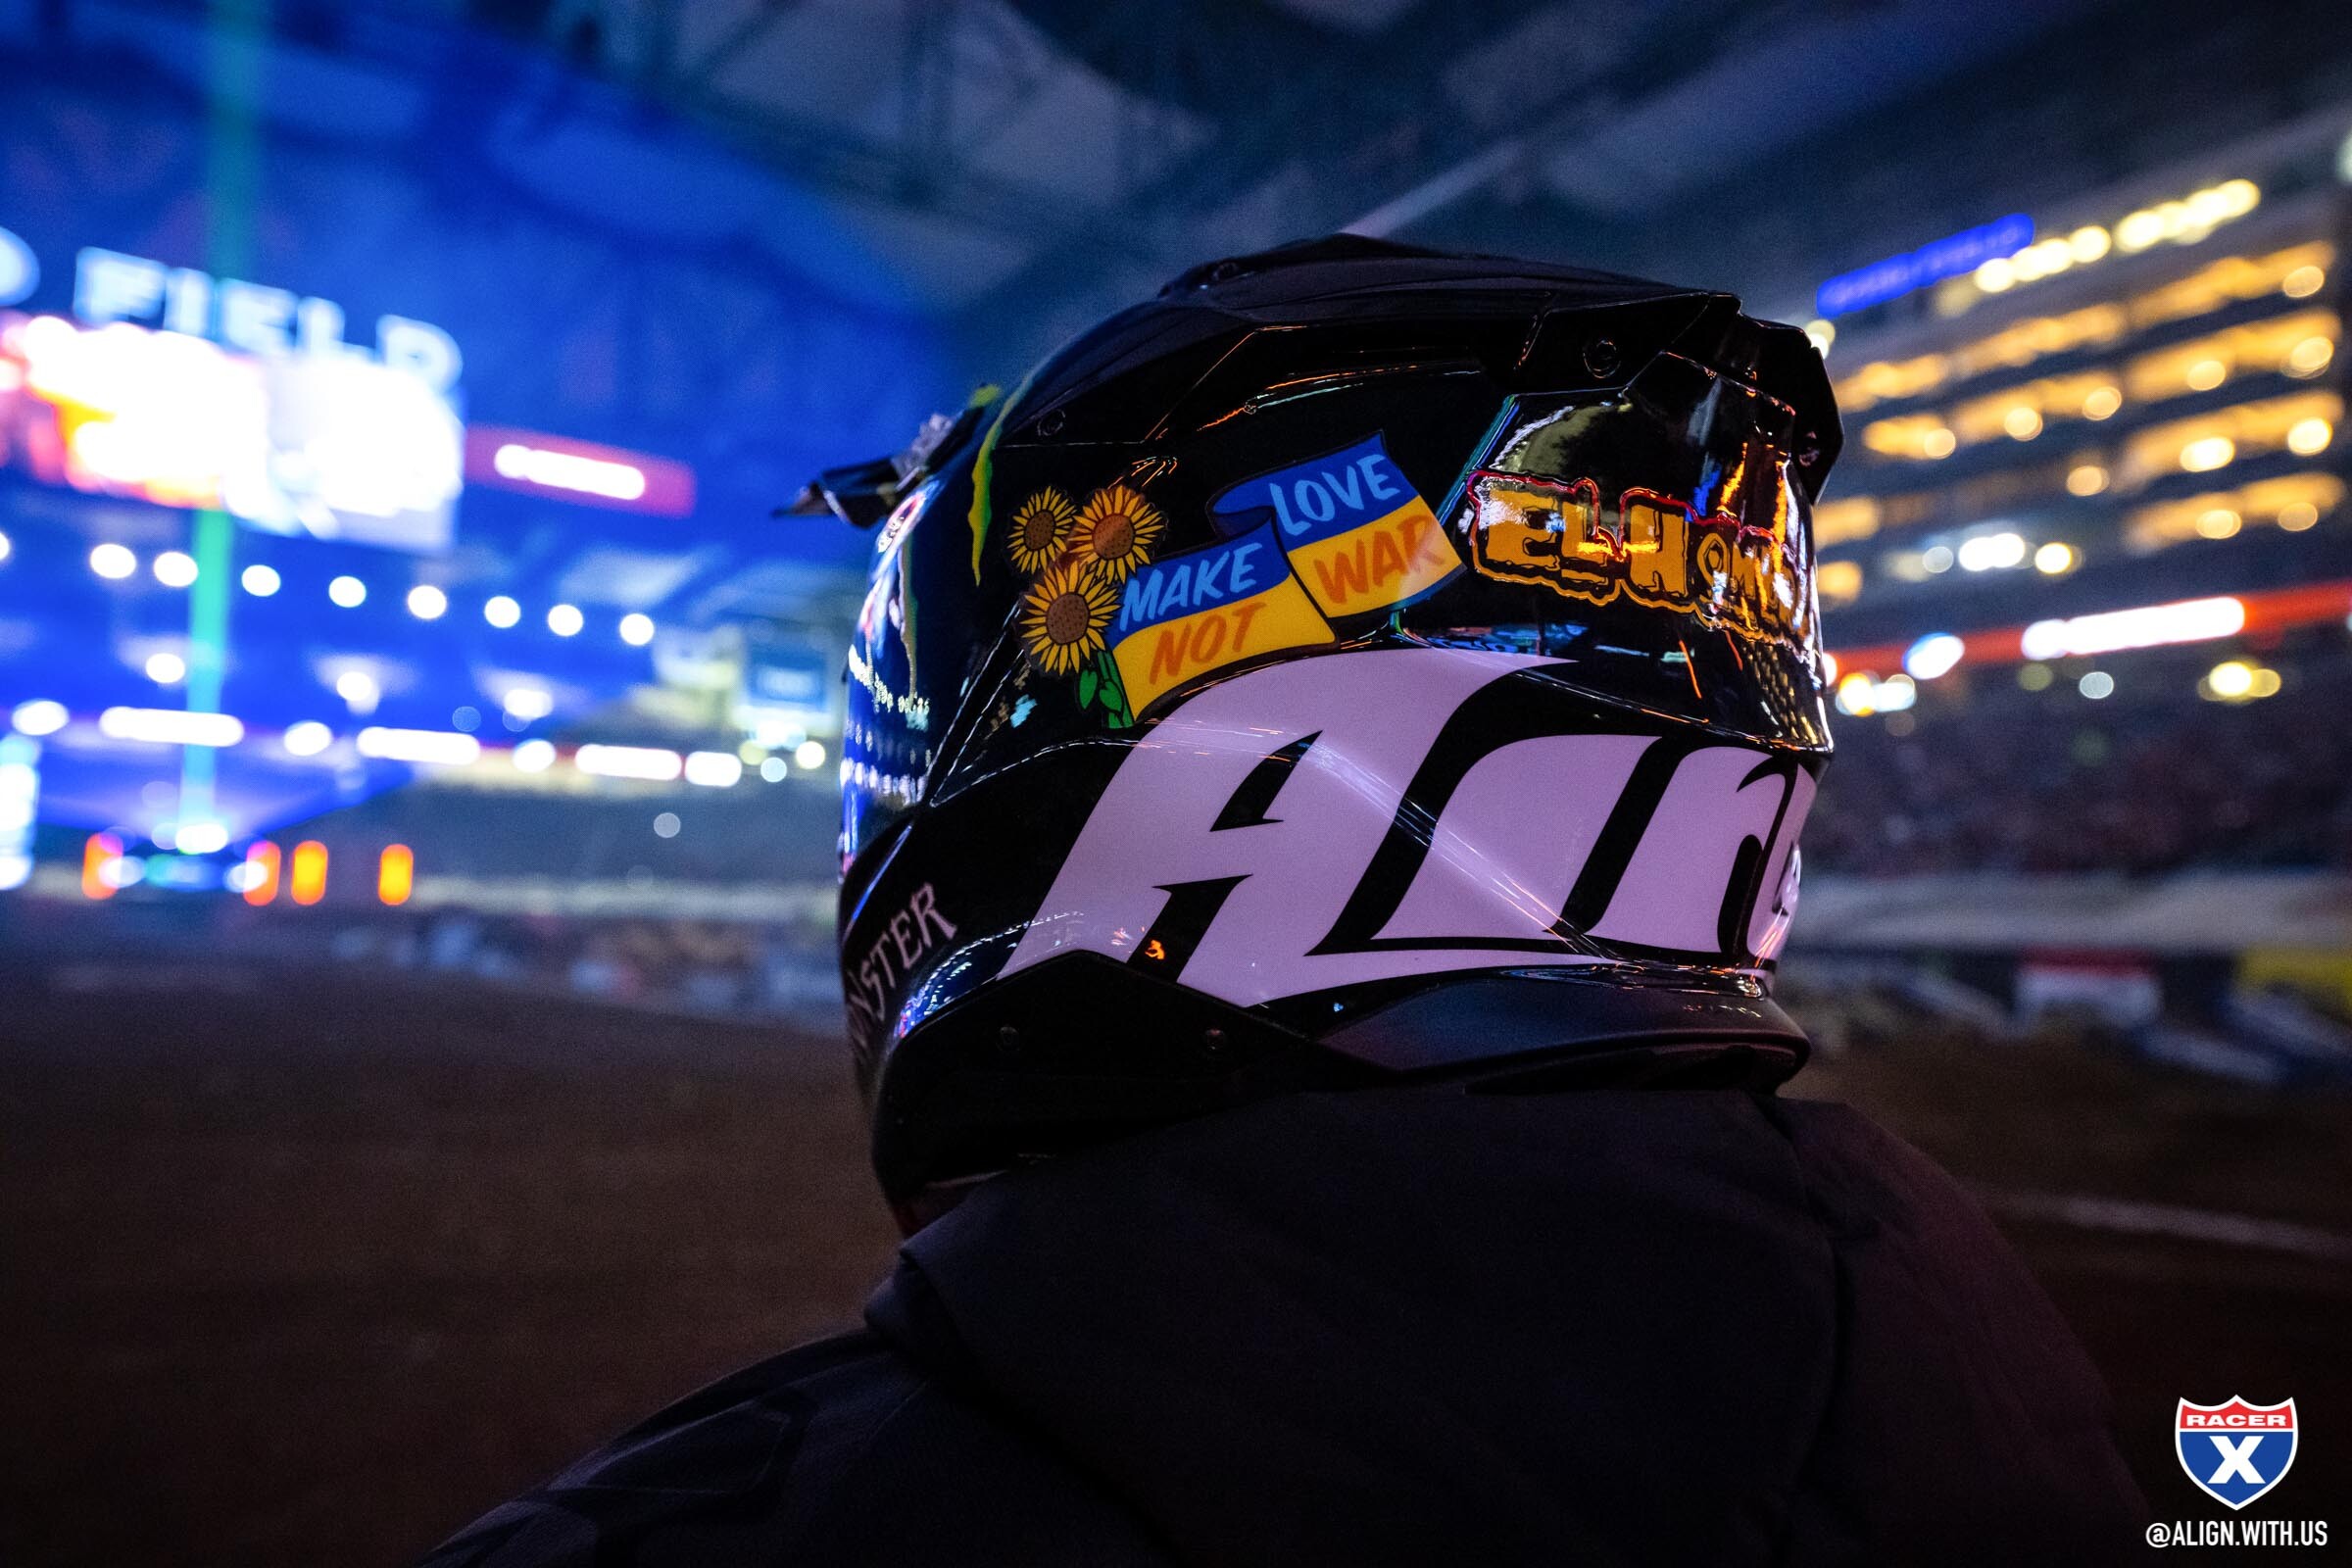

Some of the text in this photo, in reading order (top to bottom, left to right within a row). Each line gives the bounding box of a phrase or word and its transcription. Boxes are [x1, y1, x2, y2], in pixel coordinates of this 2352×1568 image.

[73, 246, 464, 395] FIELD
[1119, 454, 1401, 632] MAKE LOVE
[1149, 514, 1446, 685] NOT WAR
